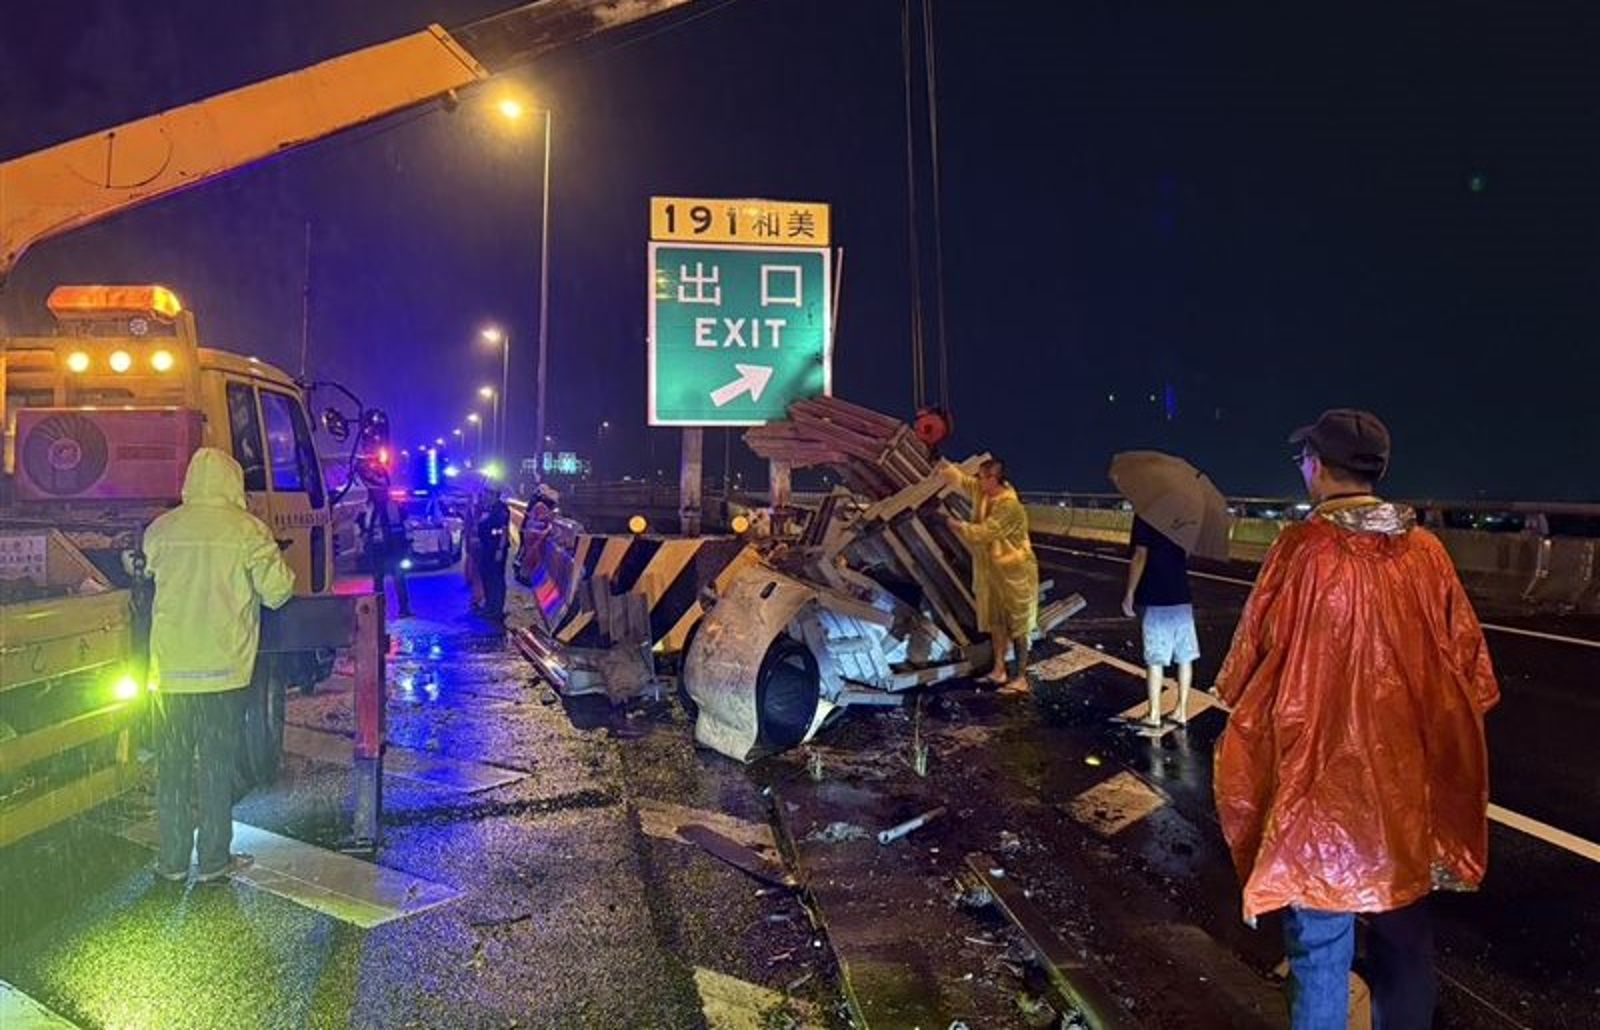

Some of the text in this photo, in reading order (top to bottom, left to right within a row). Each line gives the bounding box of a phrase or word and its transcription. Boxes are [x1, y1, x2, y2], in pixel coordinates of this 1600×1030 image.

[665, 204, 815, 238] 191 和美
[677, 262, 802, 307] 出口
[695, 317, 787, 348] EXIT
